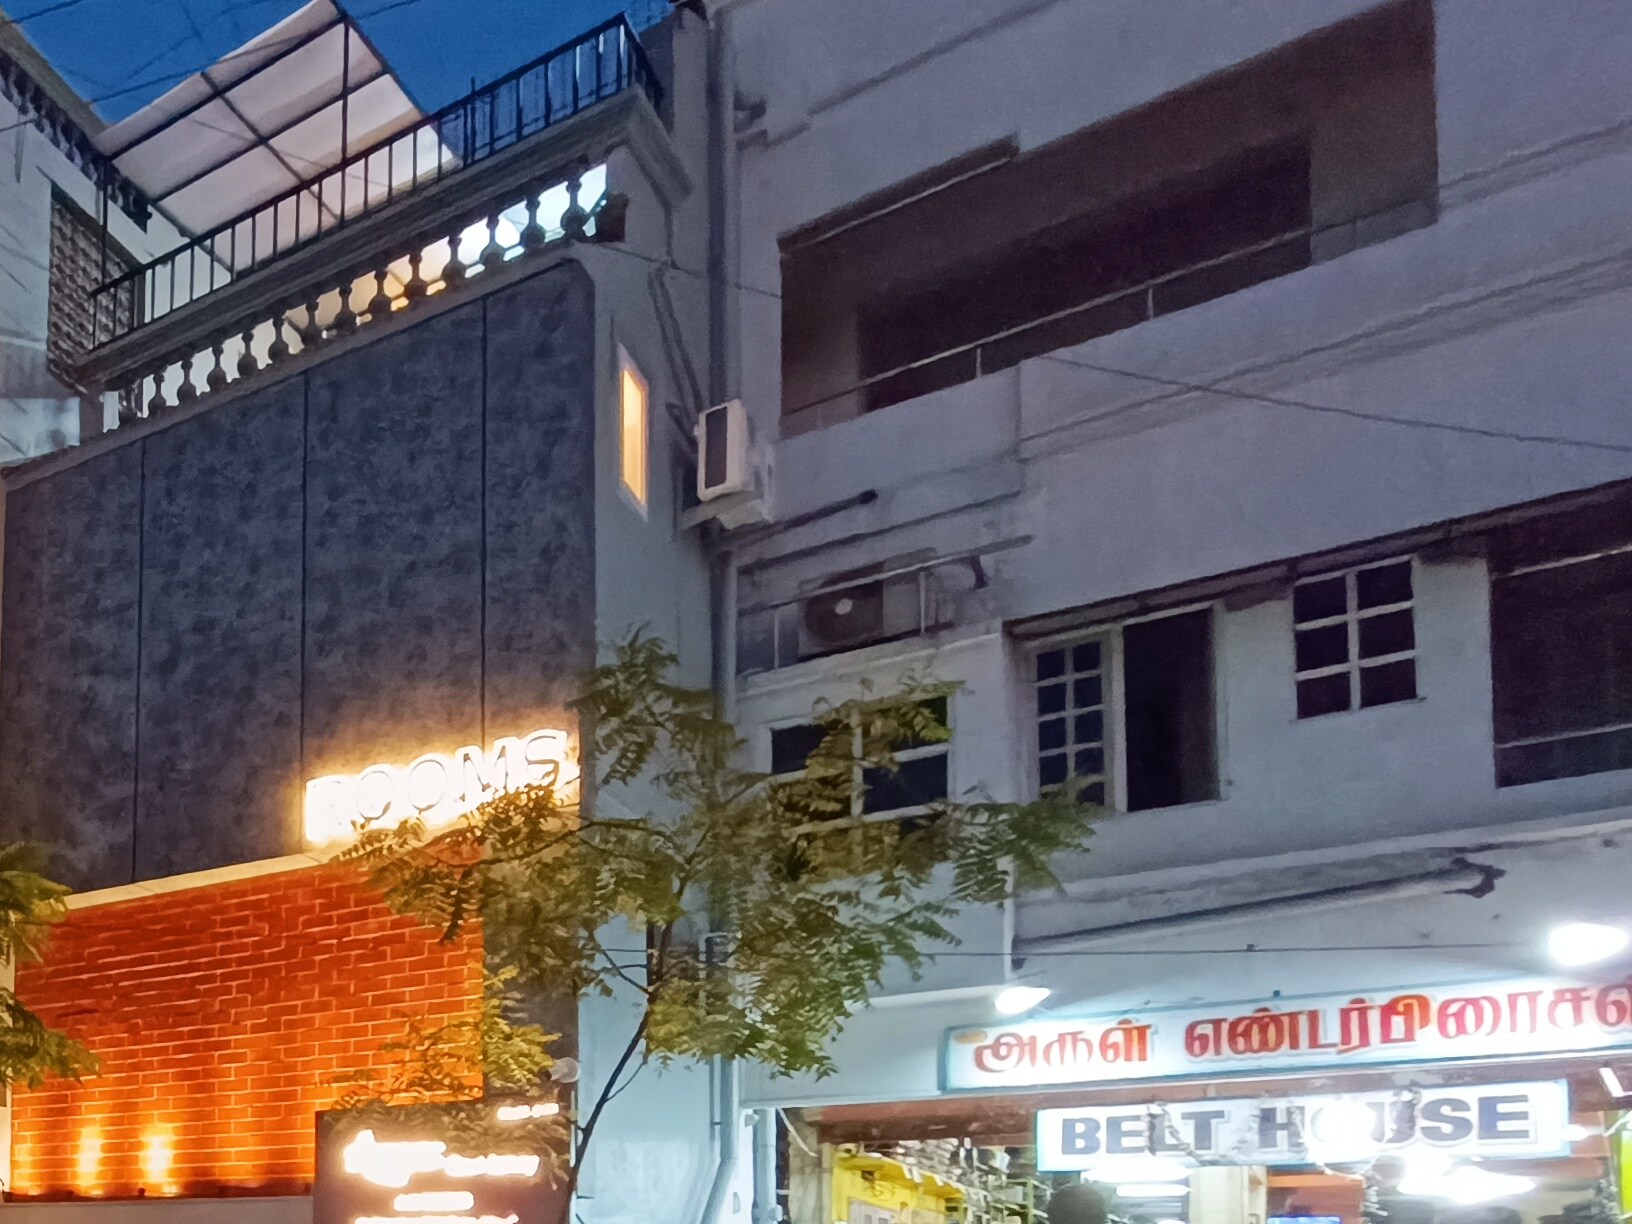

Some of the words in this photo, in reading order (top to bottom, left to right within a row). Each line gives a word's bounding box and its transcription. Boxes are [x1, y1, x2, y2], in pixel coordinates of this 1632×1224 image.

[973, 1018, 1152, 1073] அருள்
[1060, 1110, 1226, 1155] BELT
[1257, 1094, 1530, 1147] HUSE
